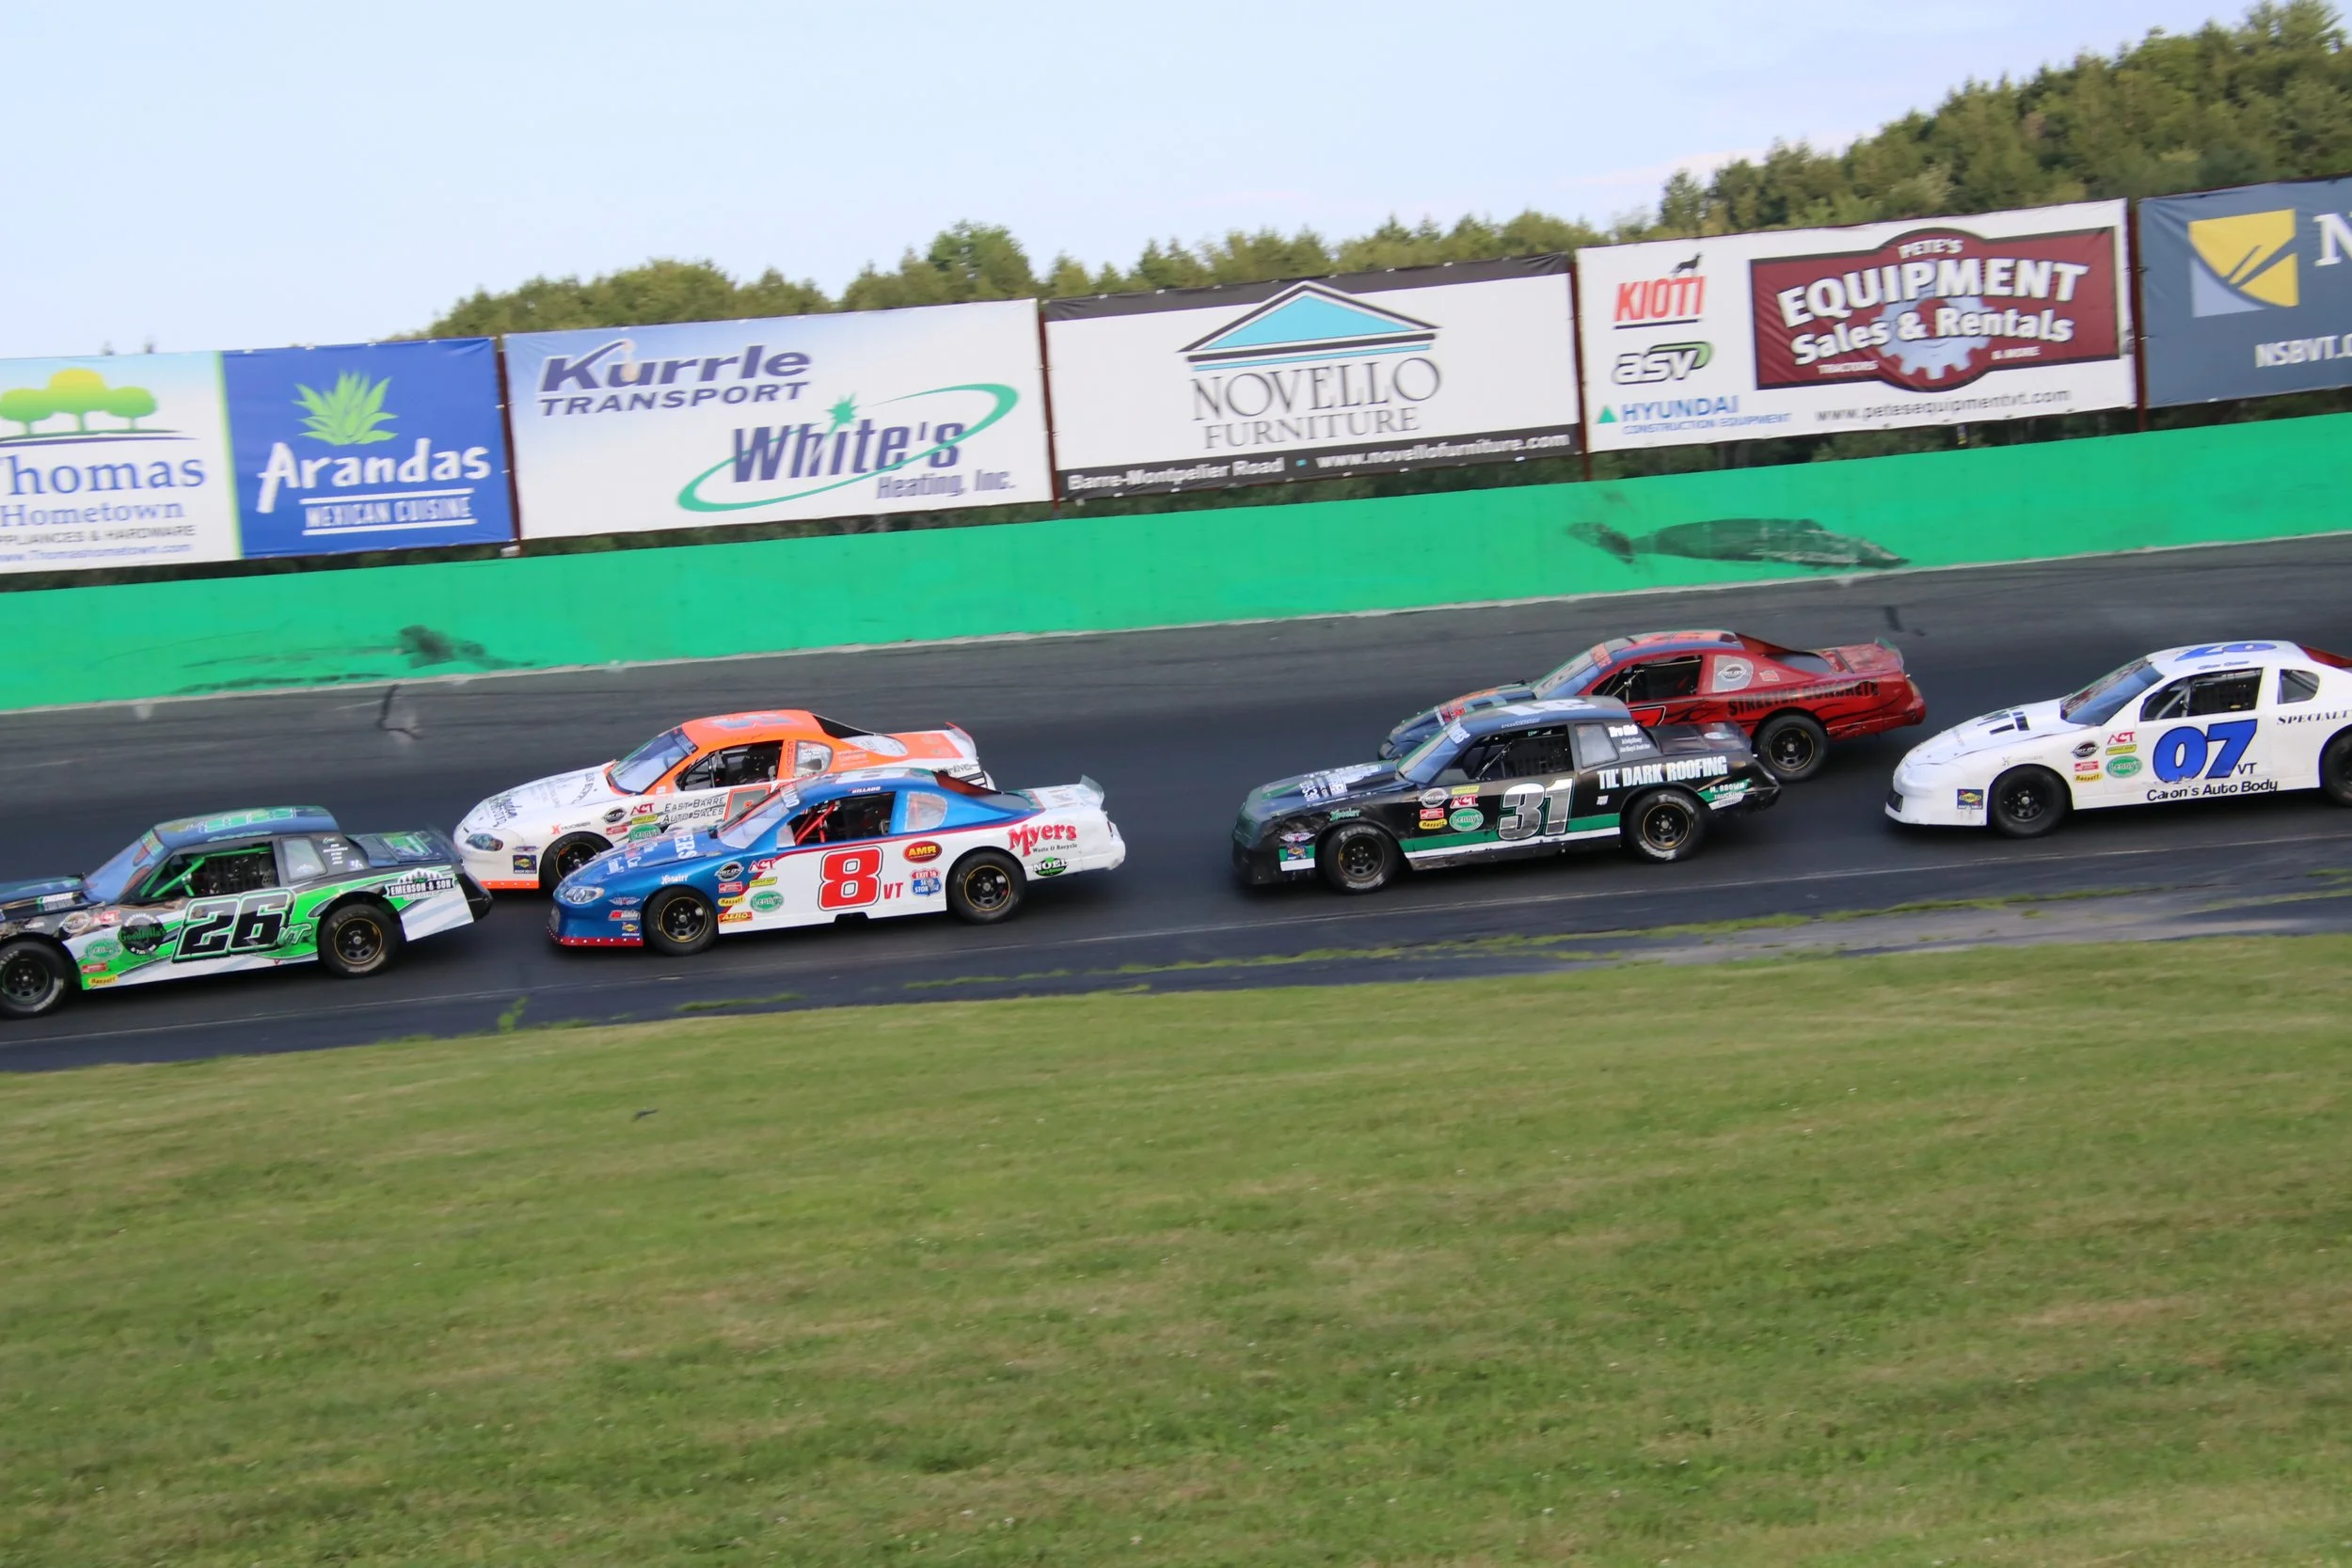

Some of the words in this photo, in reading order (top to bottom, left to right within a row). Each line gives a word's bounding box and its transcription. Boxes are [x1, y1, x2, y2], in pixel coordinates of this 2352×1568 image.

[1899, 238, 1963, 260] PETE'S
[1613, 275, 1705, 322] KIOTI
[1777, 258, 2090, 328] EQUIPMENT
[1792, 318, 1890, 367] Sales
[1897, 310, 1928, 340] &
[1935, 307, 2074, 343] Rentals
[539, 338, 811, 393] Kurrle
[538, 381, 810, 416] TRANSPORT
[1191, 357, 1440, 421] NOVELLO
[1815, 388, 2072, 423] www.petesequipmentvt.com
[1623, 396, 1739, 422] HYUNDAI
[1623, 417, 1717, 435] CONSTRUCTION
[1720, 412, 1792, 429] EQUIPMENT
[1204, 406, 1421, 450] FURNITURE
[733, 419, 966, 483] White's
[1316, 433, 1570, 469] www.novellofurniture.com
[255, 437, 491, 514] Arandas
[877, 471, 968, 499] Heating,
[975, 469, 1017, 492] Inc.
[1068, 462, 1230, 491] Barre-Montpelier
[1232, 457, 1285, 477] Road
[305, 502, 389, 529] MEXICAN
[393, 495, 472, 523] CUISINE
[105, 525, 197, 540] HARDWARE
[2277, 709, 2352, 726] SPECIALT
[2107, 731, 2136, 745] ACT
[2153, 719, 2258, 784] 07
[1622, 763, 1664, 787] DARK
[1666, 755, 1728, 782] ROOFING
[2237, 763, 2258, 775] VT
[1450, 795, 1478, 808] ACT
[1720, 782, 1745, 793] BROWN
[2147, 784, 2200, 801] Caron's
[2202, 783, 2238, 797] Auto
[2241, 779, 2279, 793] Body
[630, 802, 655, 816] ACT
[1498, 777, 1575, 841] 31
[908, 845, 937, 856] AMR
[1008, 824, 1077, 858] Myers
[748, 857, 777, 873] ACT
[818, 846, 882, 911] 8
[1032, 858, 1069, 871] NOEL
[389, 882, 426, 896] EMERSON
[429, 882, 435, 891] &
[437, 879, 452, 889] SON
[883, 881, 903, 900] VT
[172, 889, 295, 963] 26
